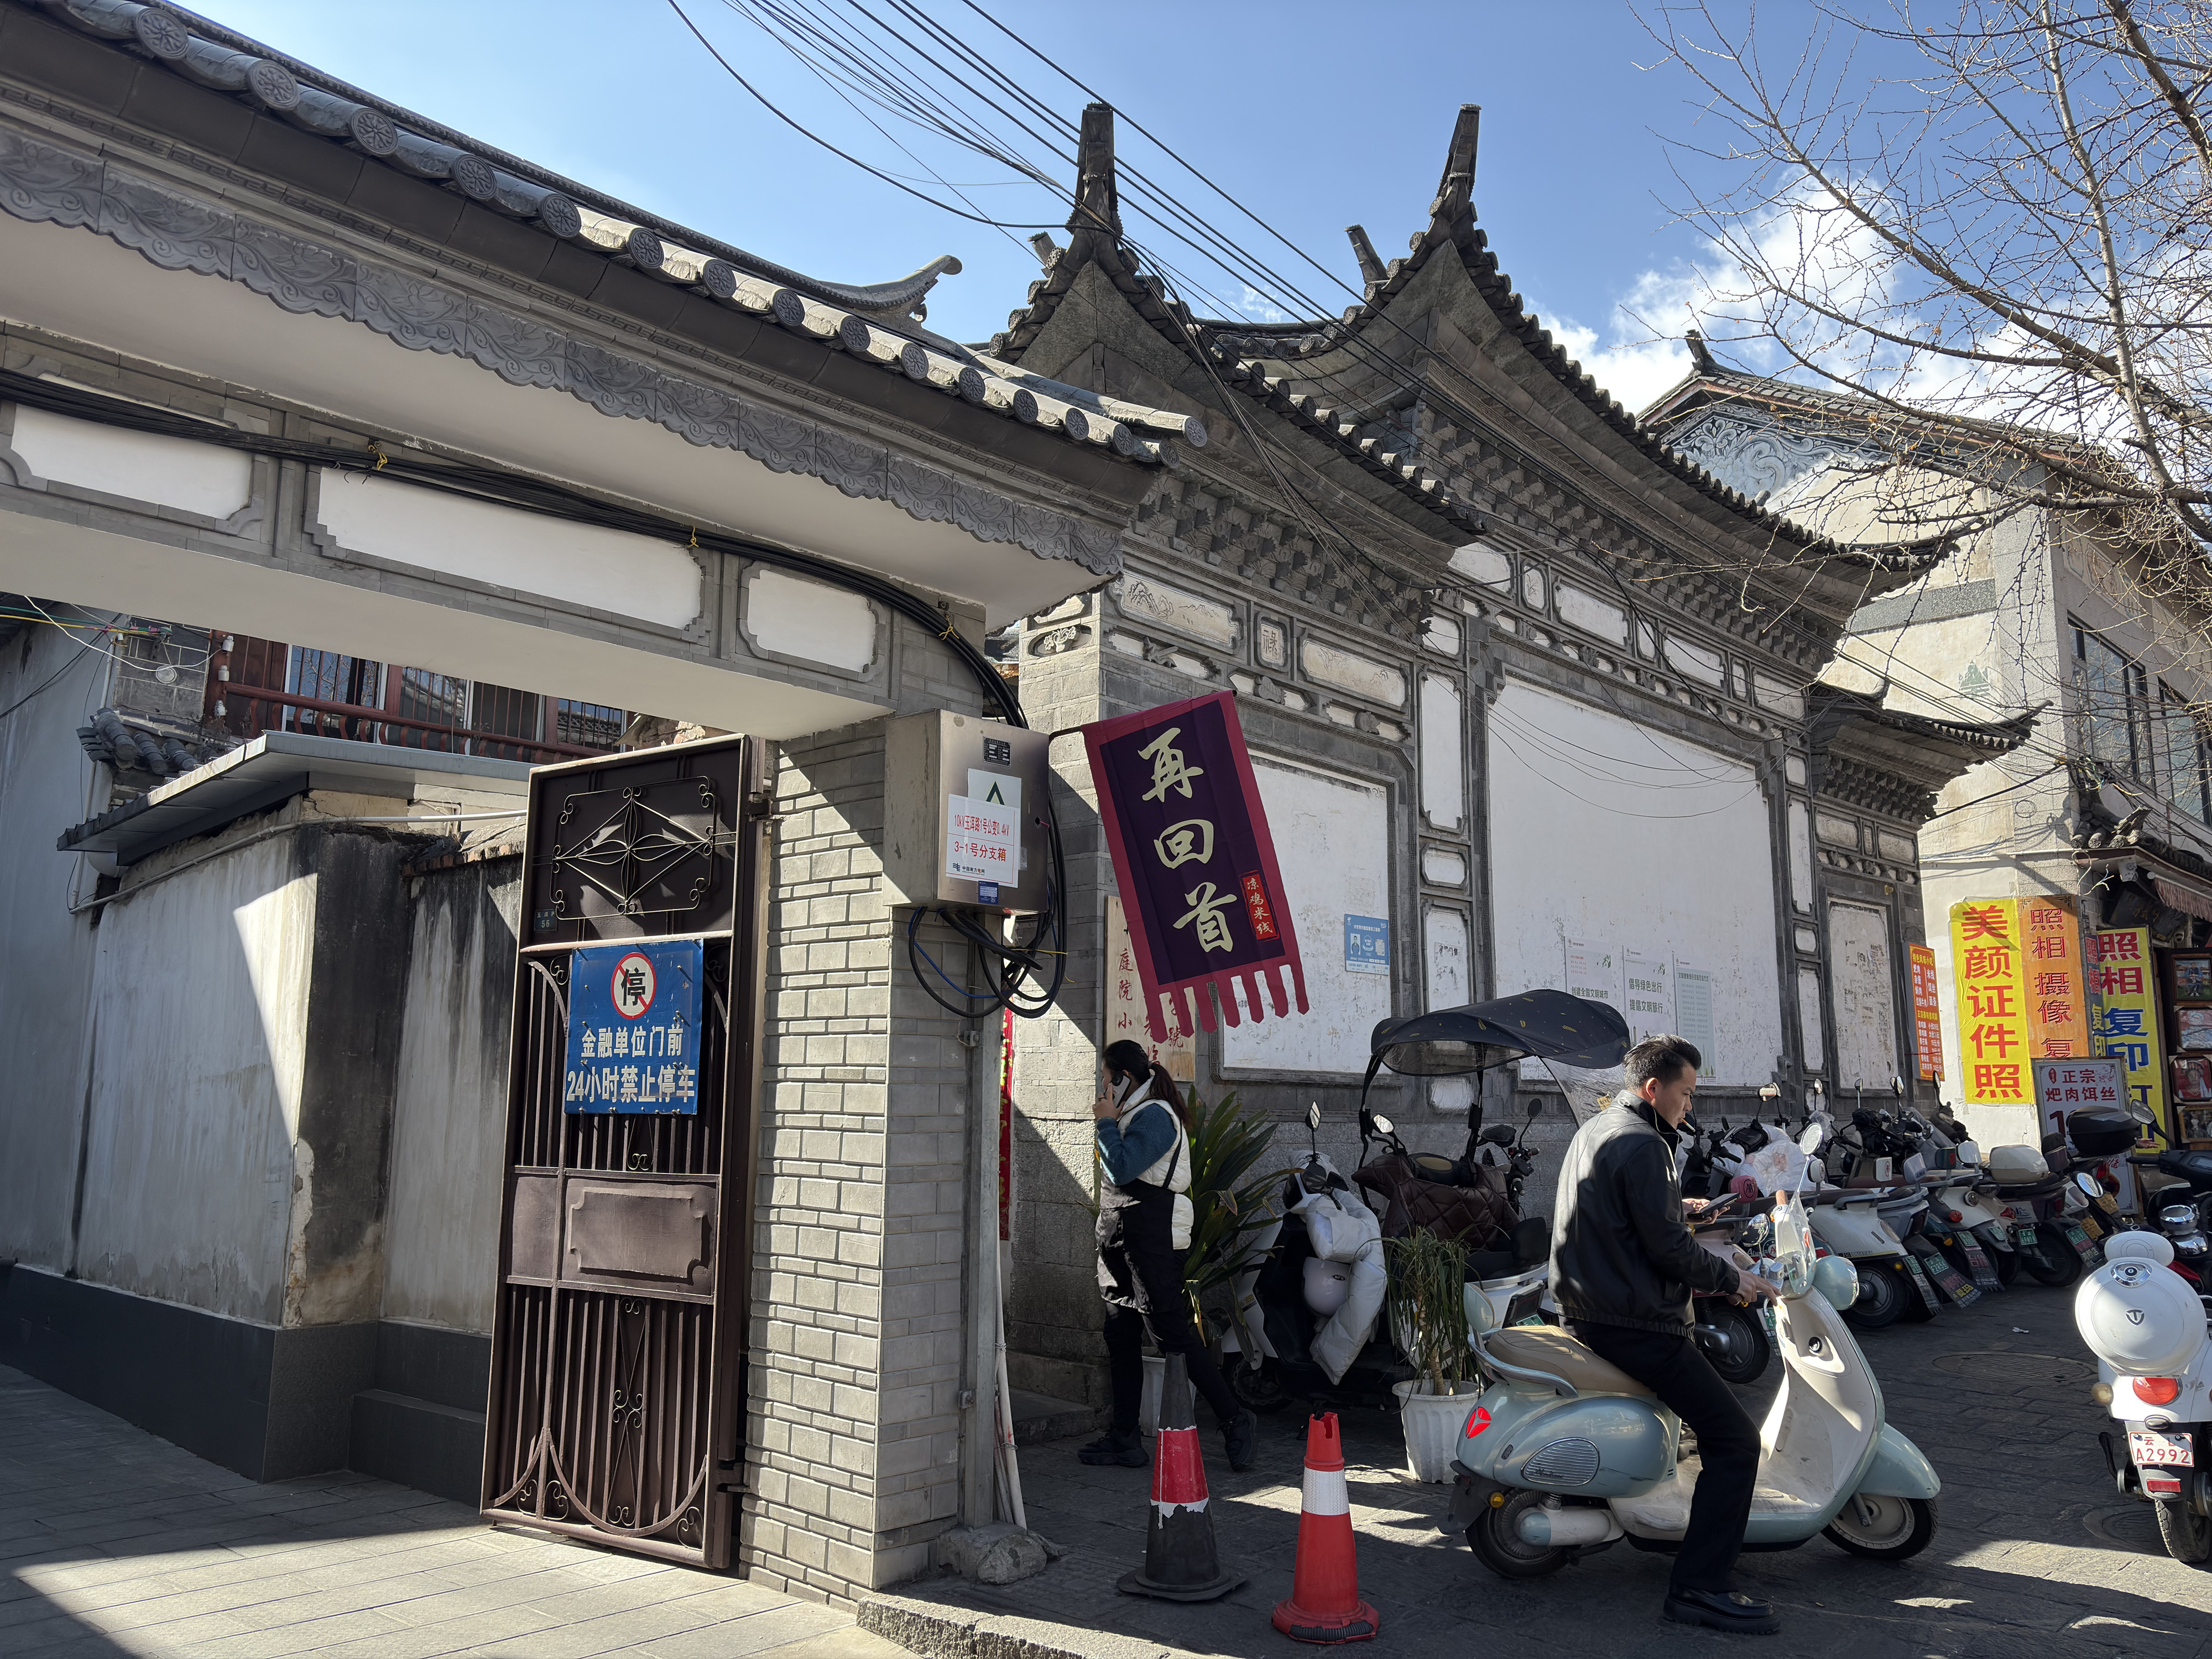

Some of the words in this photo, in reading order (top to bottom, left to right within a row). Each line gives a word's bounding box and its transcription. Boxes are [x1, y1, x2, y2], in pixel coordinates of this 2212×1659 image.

[1138, 727, 1237, 952] 再回首
[954, 841, 1006, 862] 3-1号分支箱
[1247, 878, 1273, 935] 凉鸡米线
[542, 920, 549, 928] 56
[621, 967, 646, 1006] 停
[1572, 987, 1608, 999] 创建全国文明城市
[1629, 978, 1662, 993] 倡导绿色出行
[1630, 999, 1663, 1014] 提倡文明旅行
[1961, 905, 2023, 1099] 美颜证件照
[581, 1024, 684, 1058] 金融单位门前
[566, 1065, 695, 1103] 24小时禁止停车
[2062, 1069, 2096, 1084] 正宗
[2144, 1437, 2154, 1446] 云
[2137, 1448, 2191, 1464] A2992
